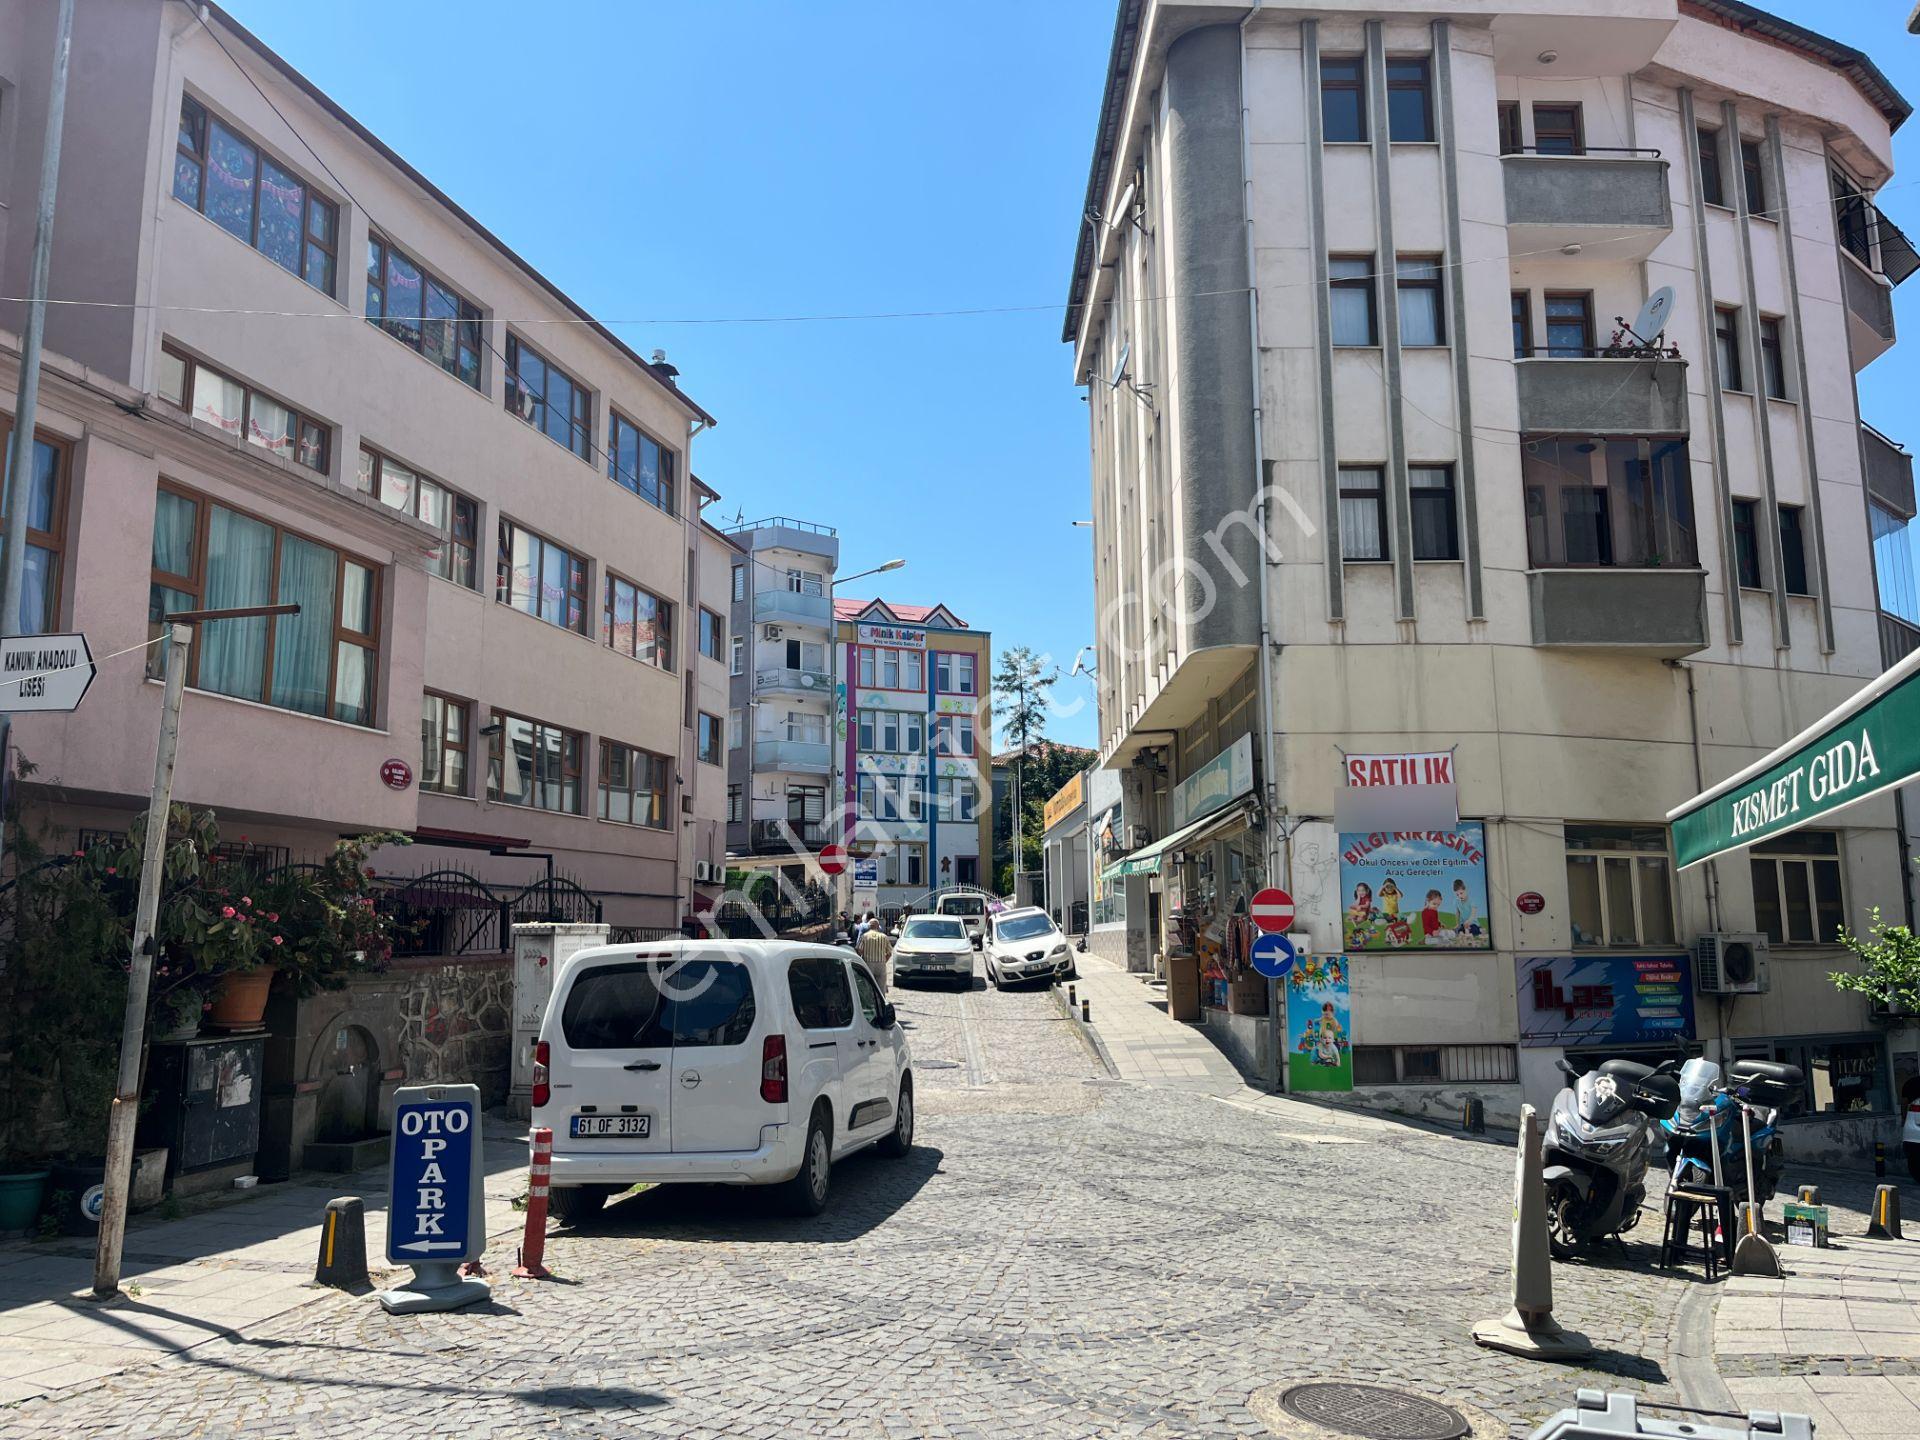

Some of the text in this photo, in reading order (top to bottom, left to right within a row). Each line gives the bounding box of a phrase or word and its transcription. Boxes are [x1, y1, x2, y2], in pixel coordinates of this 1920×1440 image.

[870, 627, 894, 639] Minik
[4, 649, 77, 672] KANUNİ ANADOLU
[1731, 728, 1881, 837] KISMET GIDA
[1359, 858, 1378, 867] Okul
[1385, 867, 1404, 878] Araç
[401, 1108, 469, 1136] OTO
[579, 1118, 646, 1133] 61 OF 3132
[414, 1138, 447, 1235] PARK
